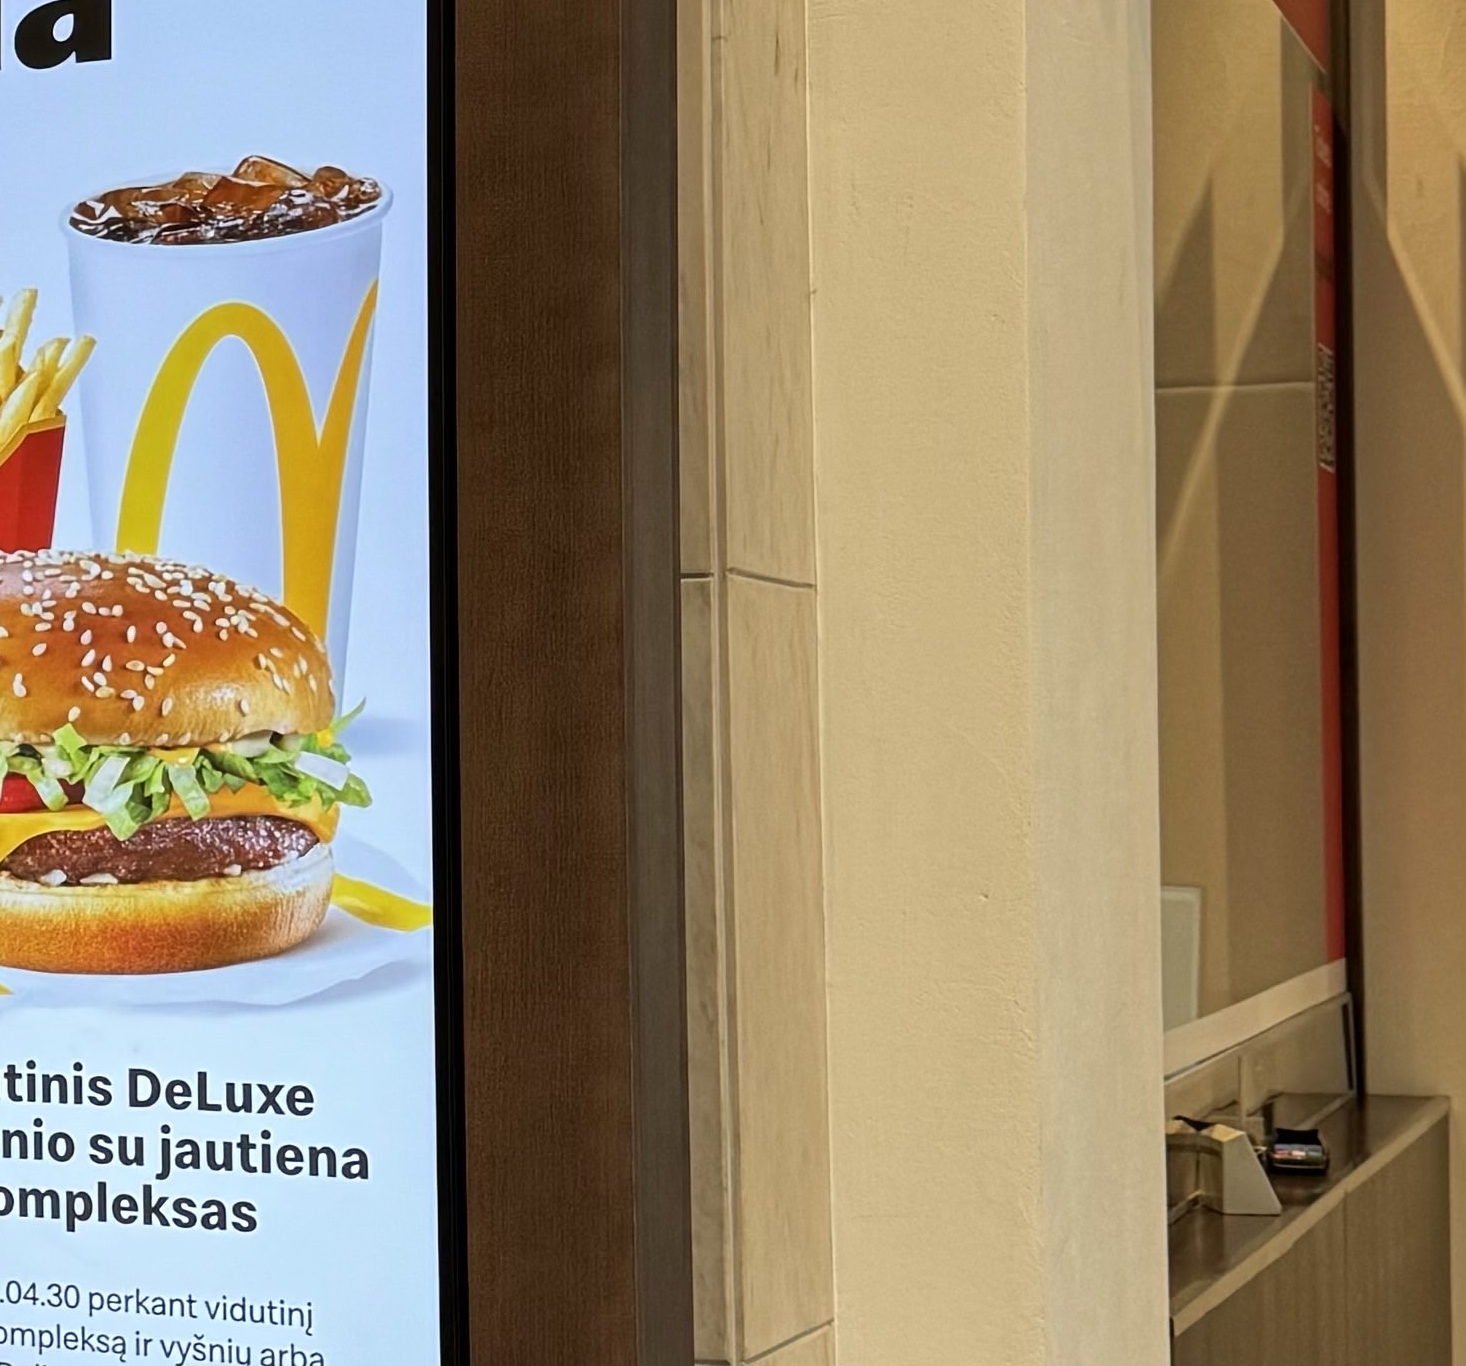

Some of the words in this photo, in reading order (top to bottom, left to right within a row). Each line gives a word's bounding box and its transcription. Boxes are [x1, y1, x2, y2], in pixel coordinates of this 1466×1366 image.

[128, 1068, 315, 1117] DeLuxe
[89, 1133, 144, 1167] su
[155, 1124, 370, 1181] jautiena
[88, 1288, 198, 1321] perkant
[204, 1296, 314, 1337] vidutinį
[135, 1327, 154, 1358] ir
